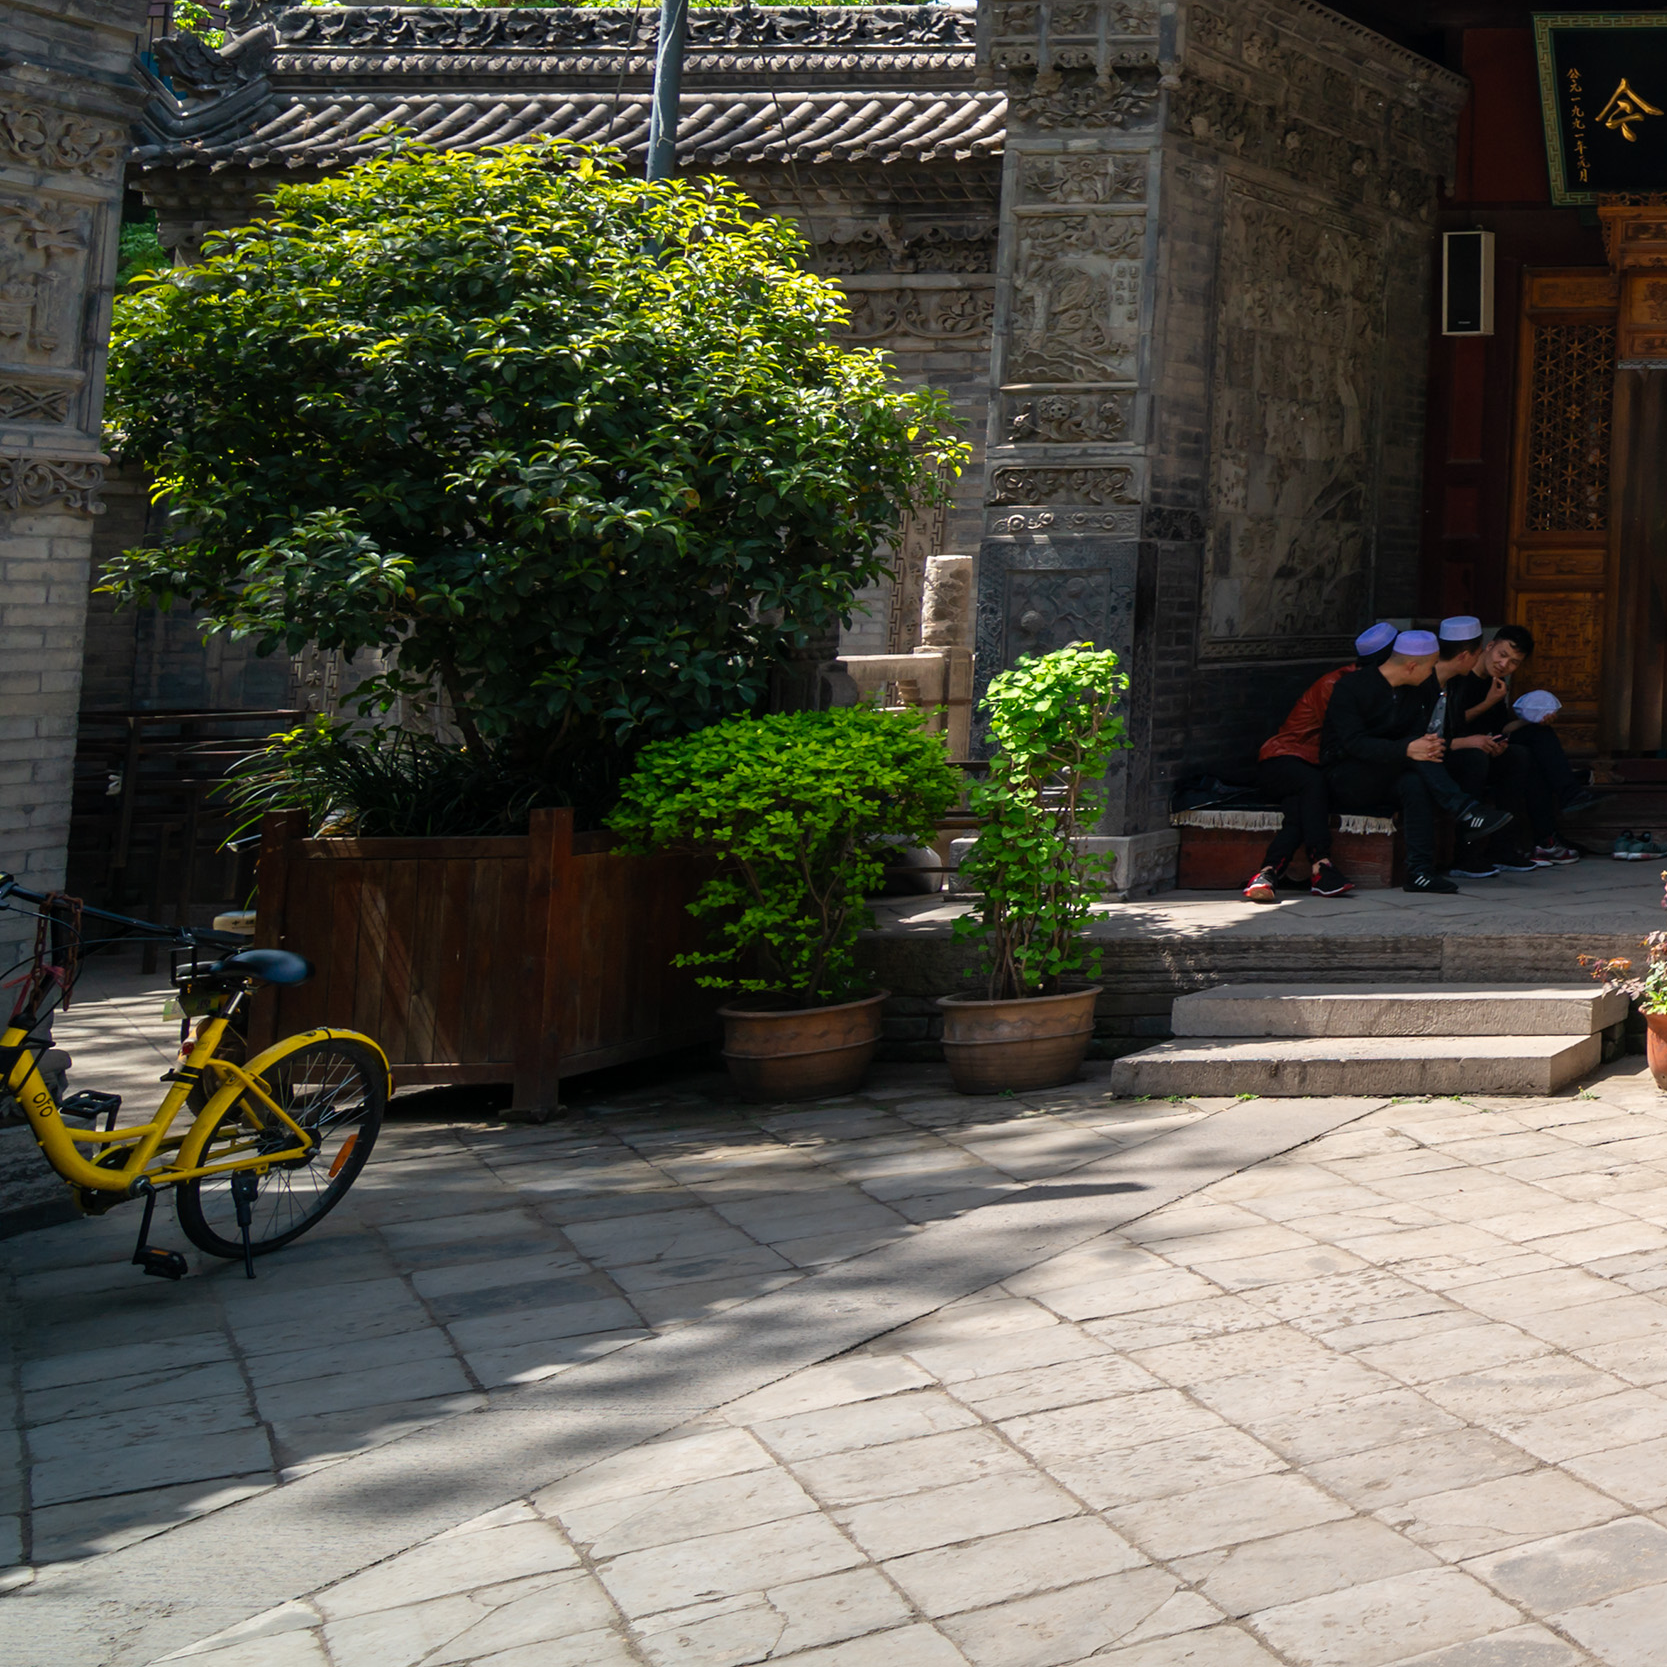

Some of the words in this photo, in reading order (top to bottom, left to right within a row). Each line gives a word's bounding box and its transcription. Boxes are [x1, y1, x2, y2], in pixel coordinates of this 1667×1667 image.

[1566, 68, 1591, 182] 公元一九九一年元月
[33, 1092, 53, 1118] ofo
